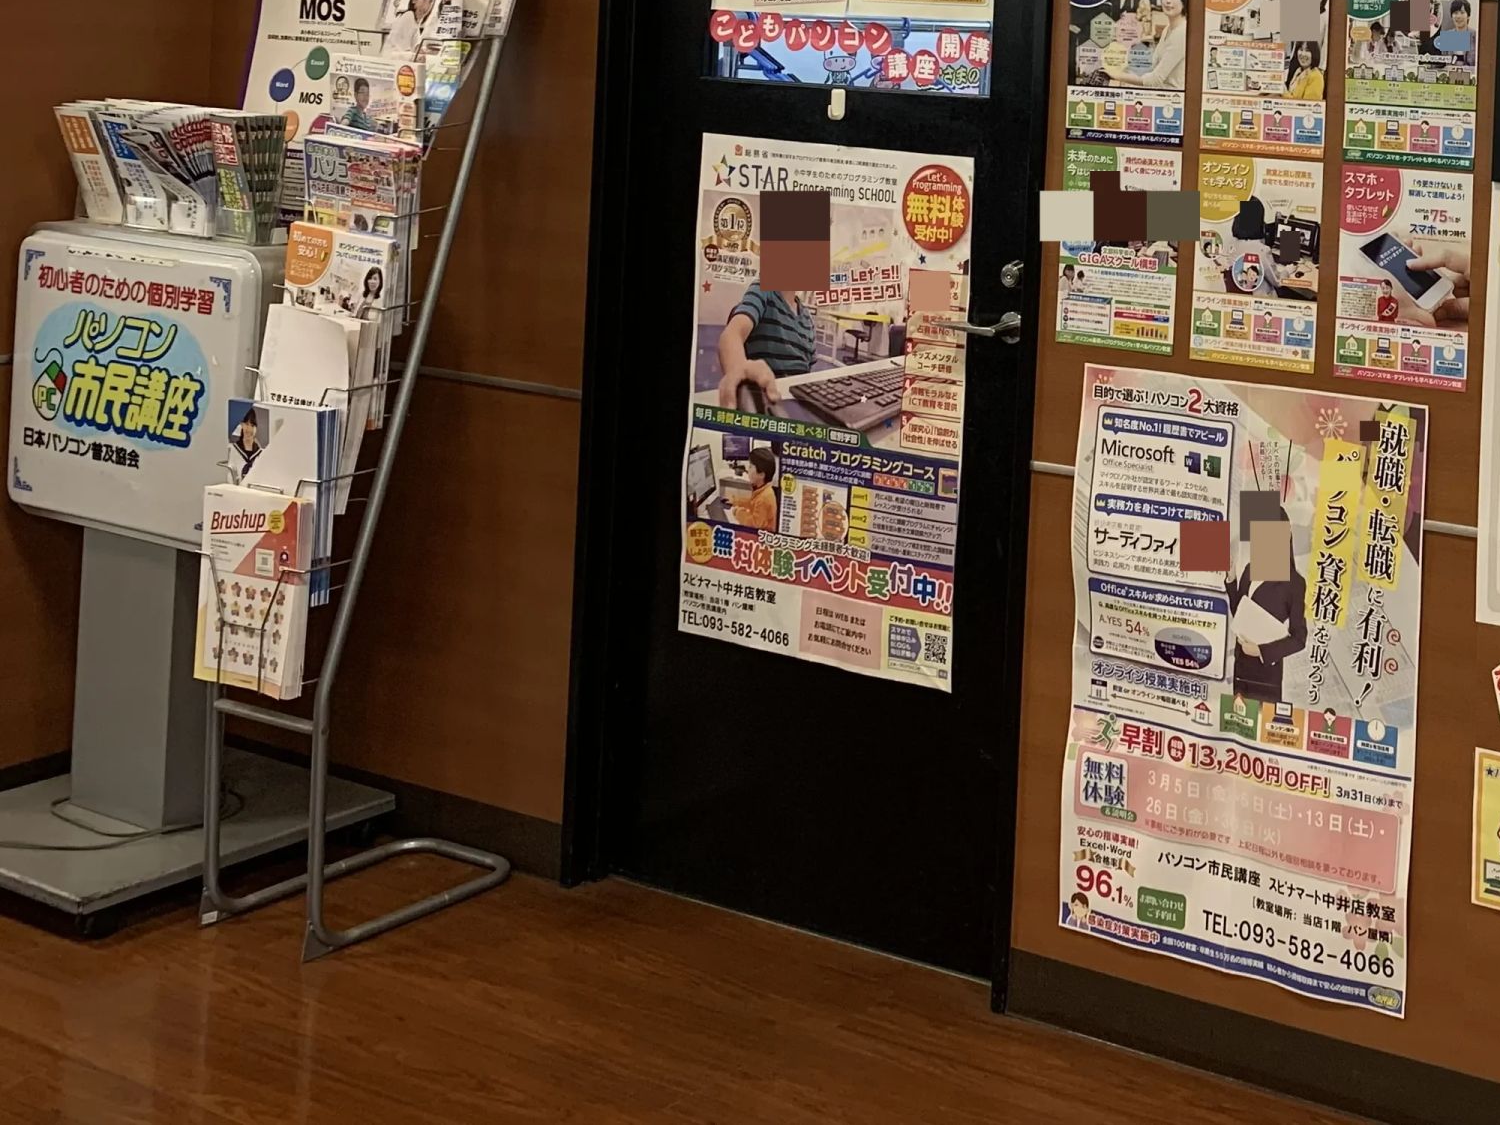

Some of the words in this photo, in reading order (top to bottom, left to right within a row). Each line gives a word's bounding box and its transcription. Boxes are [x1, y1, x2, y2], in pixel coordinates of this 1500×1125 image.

[716, 14, 888, 49] こどもパソコン
[941, 33, 990, 65] 開講
[888, 54, 936, 79] 講座
[299, 92, 324, 105] MOS
[1067, 150, 1113, 164] 未来のために
[1203, 161, 1250, 176] オンライン
[739, 166, 788, 191] STAR
[913, 180, 962, 193] Programming
[1202, 177, 1247, 189] でも学べる!
[858, 187, 897, 203] SCHOOL
[1344, 187, 1394, 201] タブレット
[1078, 253, 1159, 271] GIGAスクール構想
[38, 264, 214, 315] 初心者のための個別学習
[63, 308, 178, 364] パソコン
[36, 385, 56, 412] PC
[63, 355, 205, 448] 市民講座
[23, 426, 140, 469] 日本パソコン普及協会
[783, 442, 826, 460] Scratch
[830, 450, 935, 480] プログラミングコース
[1100, 437, 1175, 464] Microsoft
[1102, 457, 1128, 470] Office
[211, 510, 266, 533] Brushup
[1093, 526, 1178, 556] サーティファイ
[682, 572, 776, 605] スピナマート中井店教室
[682, 609, 790, 647] TEL:093-582-4066
[1120, 723, 1163, 755] 早割
[1083, 756, 1125, 784] 無料
[1188, 742, 1281, 785] 13,200円
[1284, 770, 1331, 796] OFF!
[1082, 780, 1126, 808] 体験
[1158, 851, 1261, 887] パソコン市民講座
[1269, 876, 1397, 923] スピナマート中井店教室
[1202, 910, 1395, 979] TEL:093-582-4066
